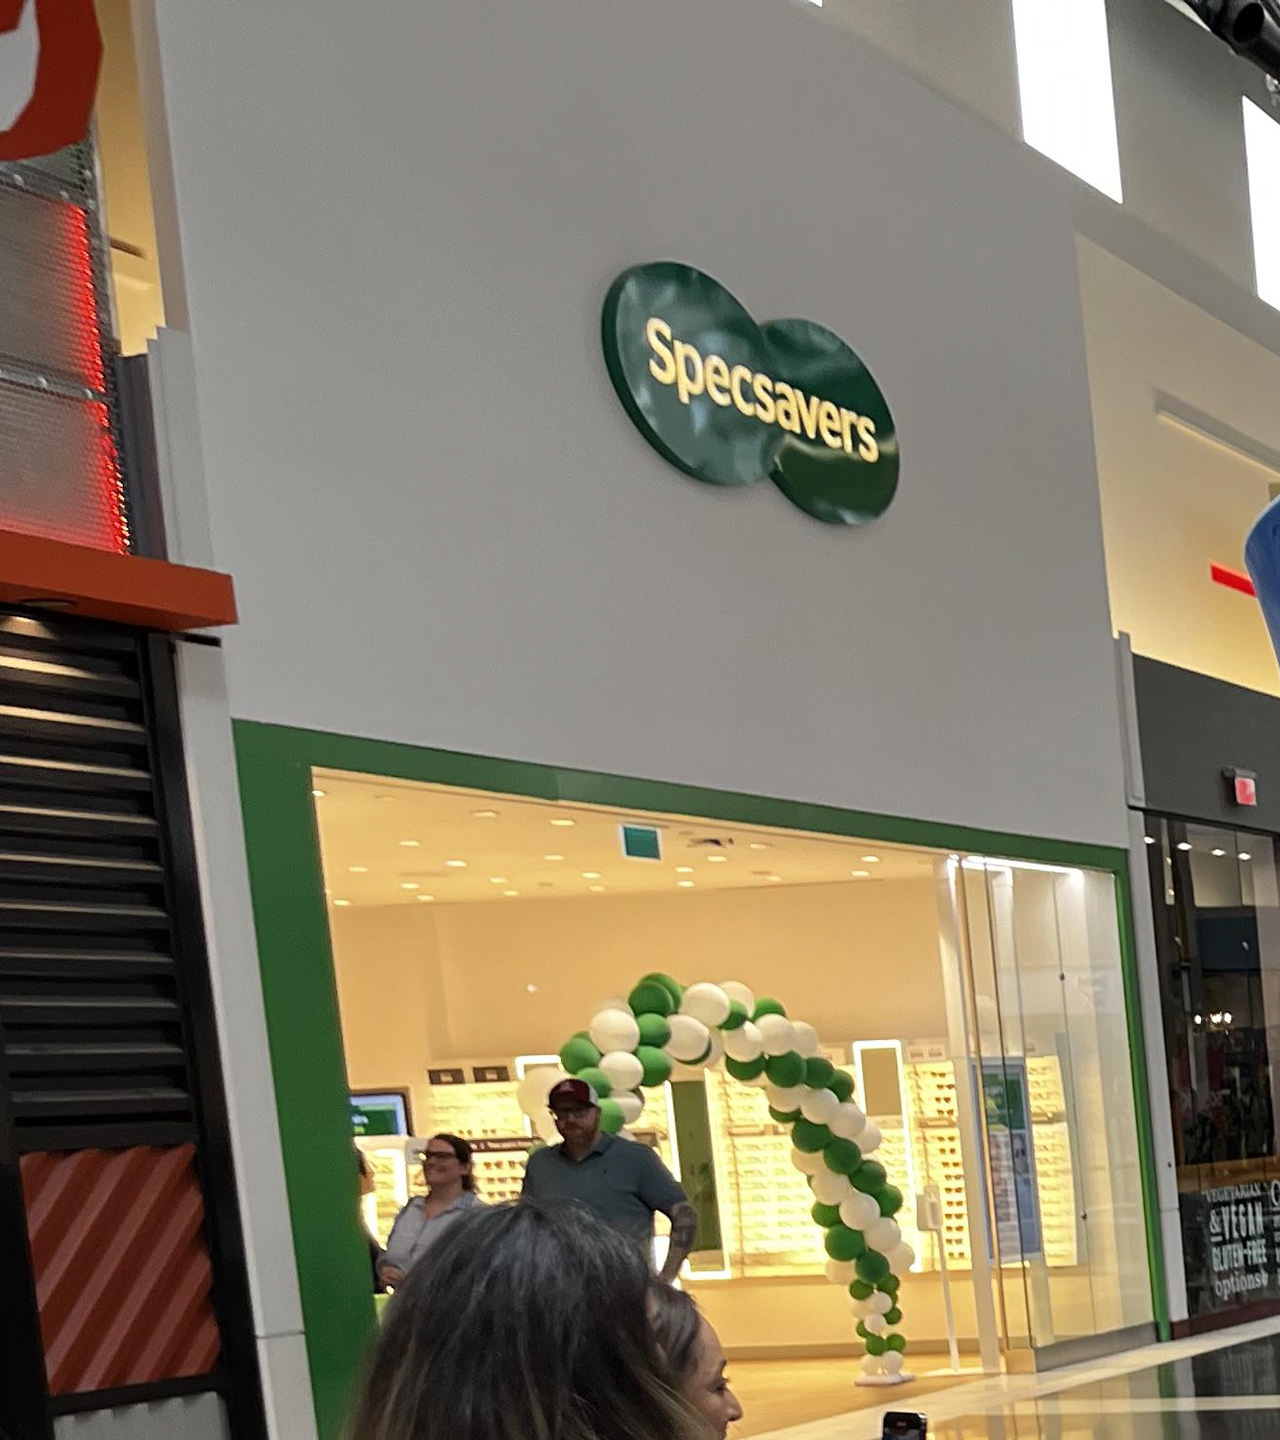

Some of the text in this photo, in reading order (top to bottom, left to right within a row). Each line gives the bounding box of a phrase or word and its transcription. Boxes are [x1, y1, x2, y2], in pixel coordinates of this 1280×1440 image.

[646, 316, 880, 464] Specsavers
[1206, 1183, 1261, 1202] VEGETARIAN
[1222, 1202, 1264, 1239] VEGAN
[1212, 1239, 1267, 1272] GLUTEN-FREE
[1215, 1272, 1262, 1300] options
